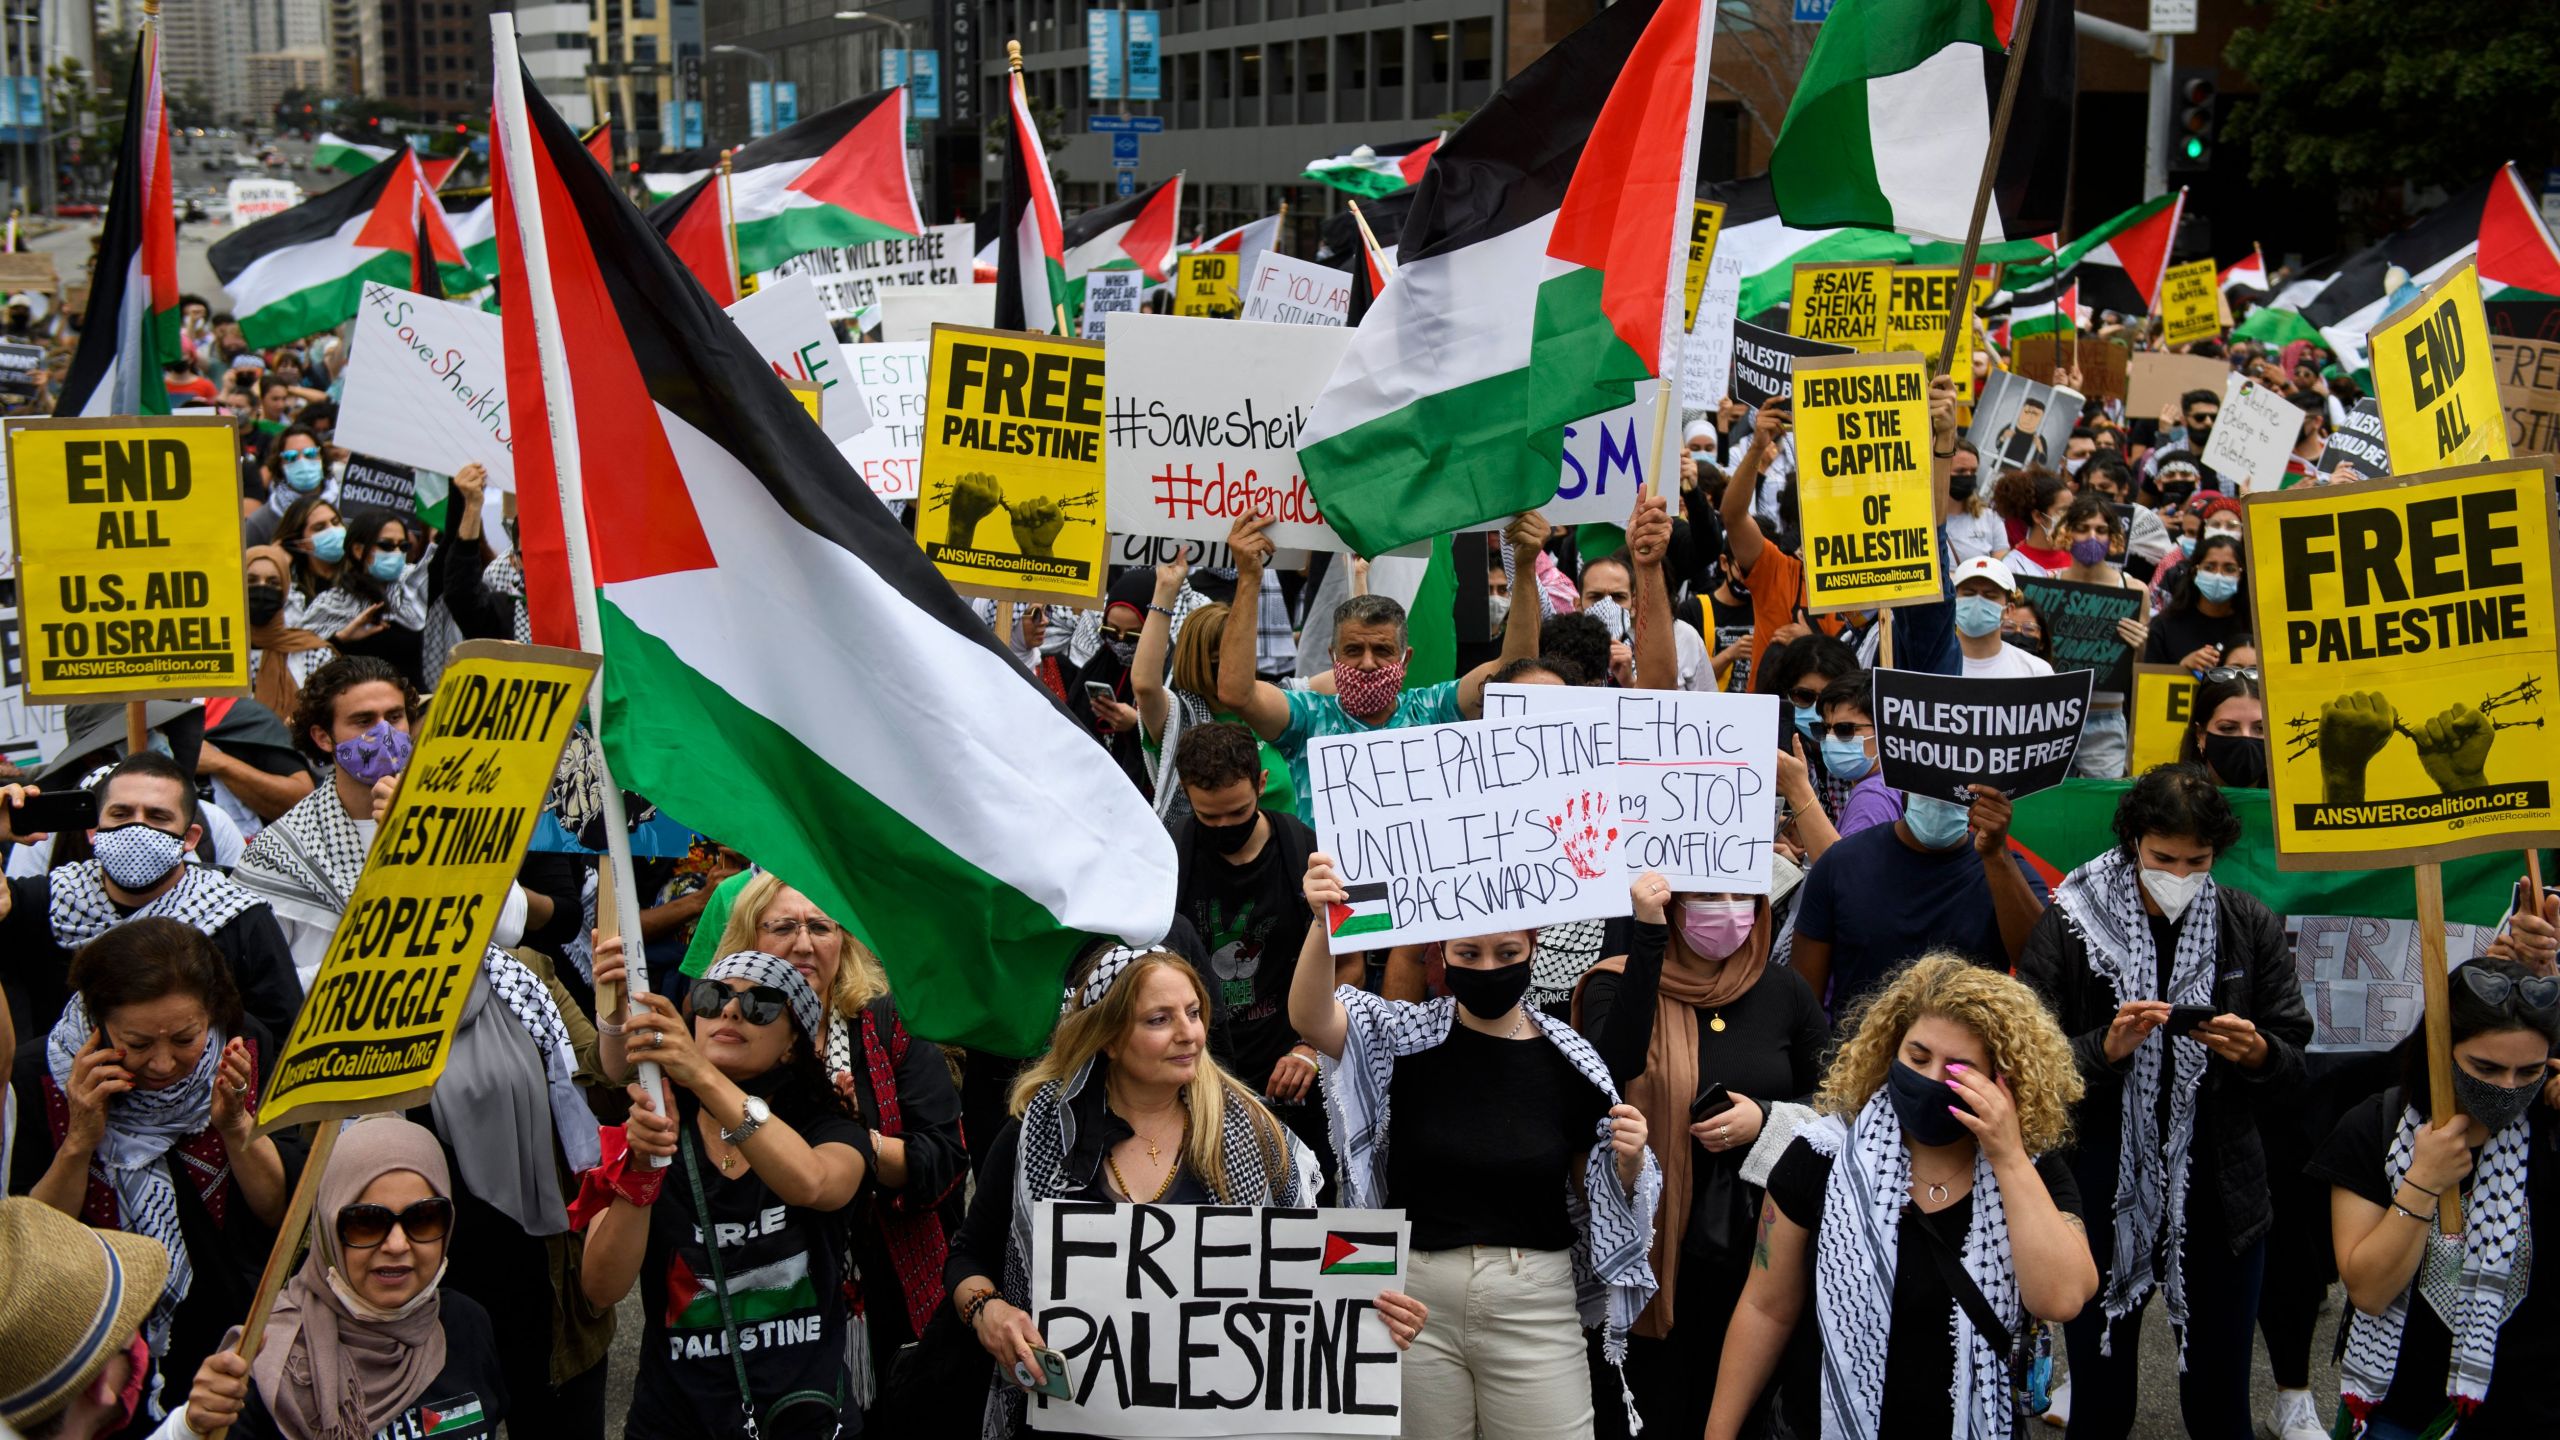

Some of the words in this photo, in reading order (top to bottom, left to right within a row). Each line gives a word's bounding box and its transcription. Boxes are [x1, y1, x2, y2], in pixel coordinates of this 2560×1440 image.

[954, 2, 969, 119] EQUINOX
[845, 241, 881, 271] WILL
[884, 238, 903, 265] BE
[907, 233, 945, 261] FREE
[1192, 259, 1225, 280] END
[835, 279, 877, 311] RIVER
[1091, 288, 1121, 299] PEOPLE
[1105, 275, 1129, 287] WHEN
[1196, 283, 1216, 295] ALL
[1257, 267, 1279, 291] IF
[1287, 272, 1323, 304] YOU
[1813, 271, 1874, 294] #SAVE
[1249, 296, 1268, 319] IN
[1273, 303, 1345, 327] SITUATIO
[1804, 294, 1876, 317] SHEIKH
[1800, 316, 1876, 339] JARRAH
[1736, 336, 1792, 374] PALESTI
[2404, 298, 2465, 412] END
[2493, 344, 2560, 391] FRE
[947, 343, 1105, 426] FREE
[1737, 362, 1780, 396] SHOULD
[1803, 373, 1922, 408] JERUSALEM
[942, 416, 1099, 463] PALESTINE
[1837, 412, 1860, 441] IS
[1864, 409, 1901, 437] THE
[2435, 392, 2471, 460] ALL
[65, 438, 192, 504] END
[1821, 441, 1917, 478] CAPITAL
[342, 484, 394, 507] SHOULD
[1863, 494, 1891, 526] OF
[96, 510, 170, 550] ALL
[1814, 527, 1929, 568] PALESTINE
[2280, 488, 2523, 612] FREE
[936, 546, 1078, 577] ANSWERcoalition.org
[1825, 569, 1926, 588] ANSWERcoalition.org
[60, 575, 137, 614] U.S.
[145, 570, 209, 609] AID
[41, 621, 92, 657] TO
[95, 616, 231, 655] ISRAEL!
[2287, 593, 2528, 665] PALESTINE
[57, 657, 220, 677] ANSWERcoalition.org
[1617, 696, 1744, 764] Ethic
[1882, 696, 2081, 737] PALESTINIANS
[467, 747, 502, 796] the
[1318, 738, 1433, 825] FREE
[1433, 721, 1616, 799] PALESTINE
[1885, 735, 1984, 774] SHOULD
[1989, 747, 2020, 774] BE
[2024, 734, 2075, 770] FREE
[1660, 766, 1763, 826] STOP
[2313, 788, 2529, 827] ANSWERcoalition.org
[2465, 810, 2550, 827] @ANSWERcoalition
[1336, 818, 1456, 881] UNTIL
[1392, 857, 1579, 930] BACKWARDS
[328, 892, 483, 969] PEOPLE'S
[298, 963, 461, 1045] STRUGGLE
[693, 1205, 787, 1249] FRE
[1051, 1202, 1321, 1300] FREE
[669, 1314, 822, 1361] PALSTINE
